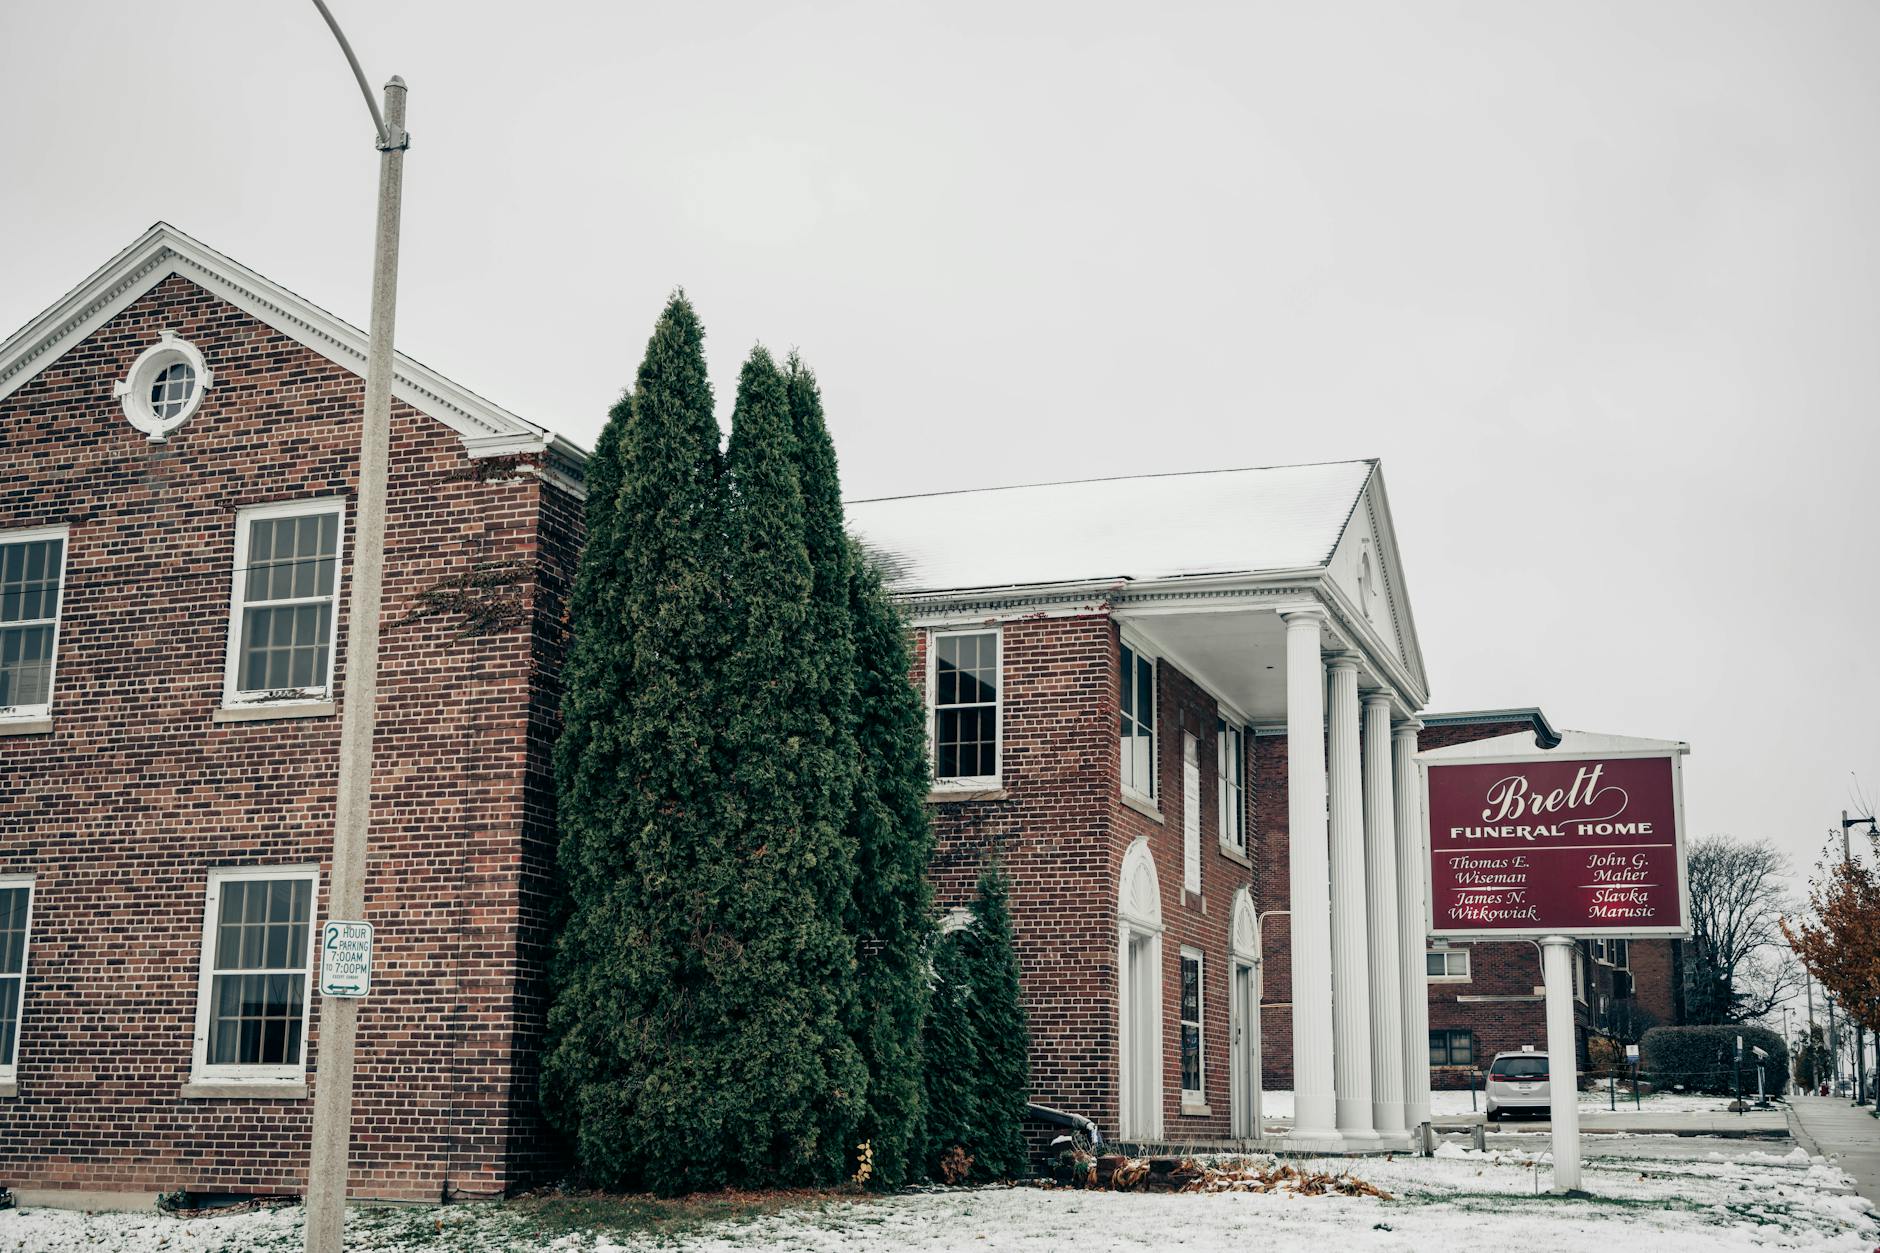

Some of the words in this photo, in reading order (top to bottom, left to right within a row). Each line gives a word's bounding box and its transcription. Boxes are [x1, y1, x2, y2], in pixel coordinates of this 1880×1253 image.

[1482, 764, 1628, 823] Brett
[1450, 825, 1565, 840] FUNERAL
[1578, 822, 1653, 836] HOME
[1449, 856, 1508, 869] Thomas
[1512, 856, 1530, 868] E.
[1586, 852, 1626, 868] John
[1631, 853, 1649, 866] G.
[1455, 871, 1526, 885] Wiseman
[1593, 867, 1648, 882] Maher
[1455, 891, 1503, 906] James
[1506, 890, 1526, 904] N.
[1592, 888, 1648, 904] Slavka
[1448, 905, 1541, 922] Witkowiak
[1588, 903, 1655, 918] Marusic
[327, 928, 339, 949] 2
[343, 928, 366, 939] HOUR
[339, 940, 369, 952] PARKING
[331, 951, 363, 963] 7:00AM
[326, 963, 333, 972] TO
[335, 962, 367, 974] 7:00PM
